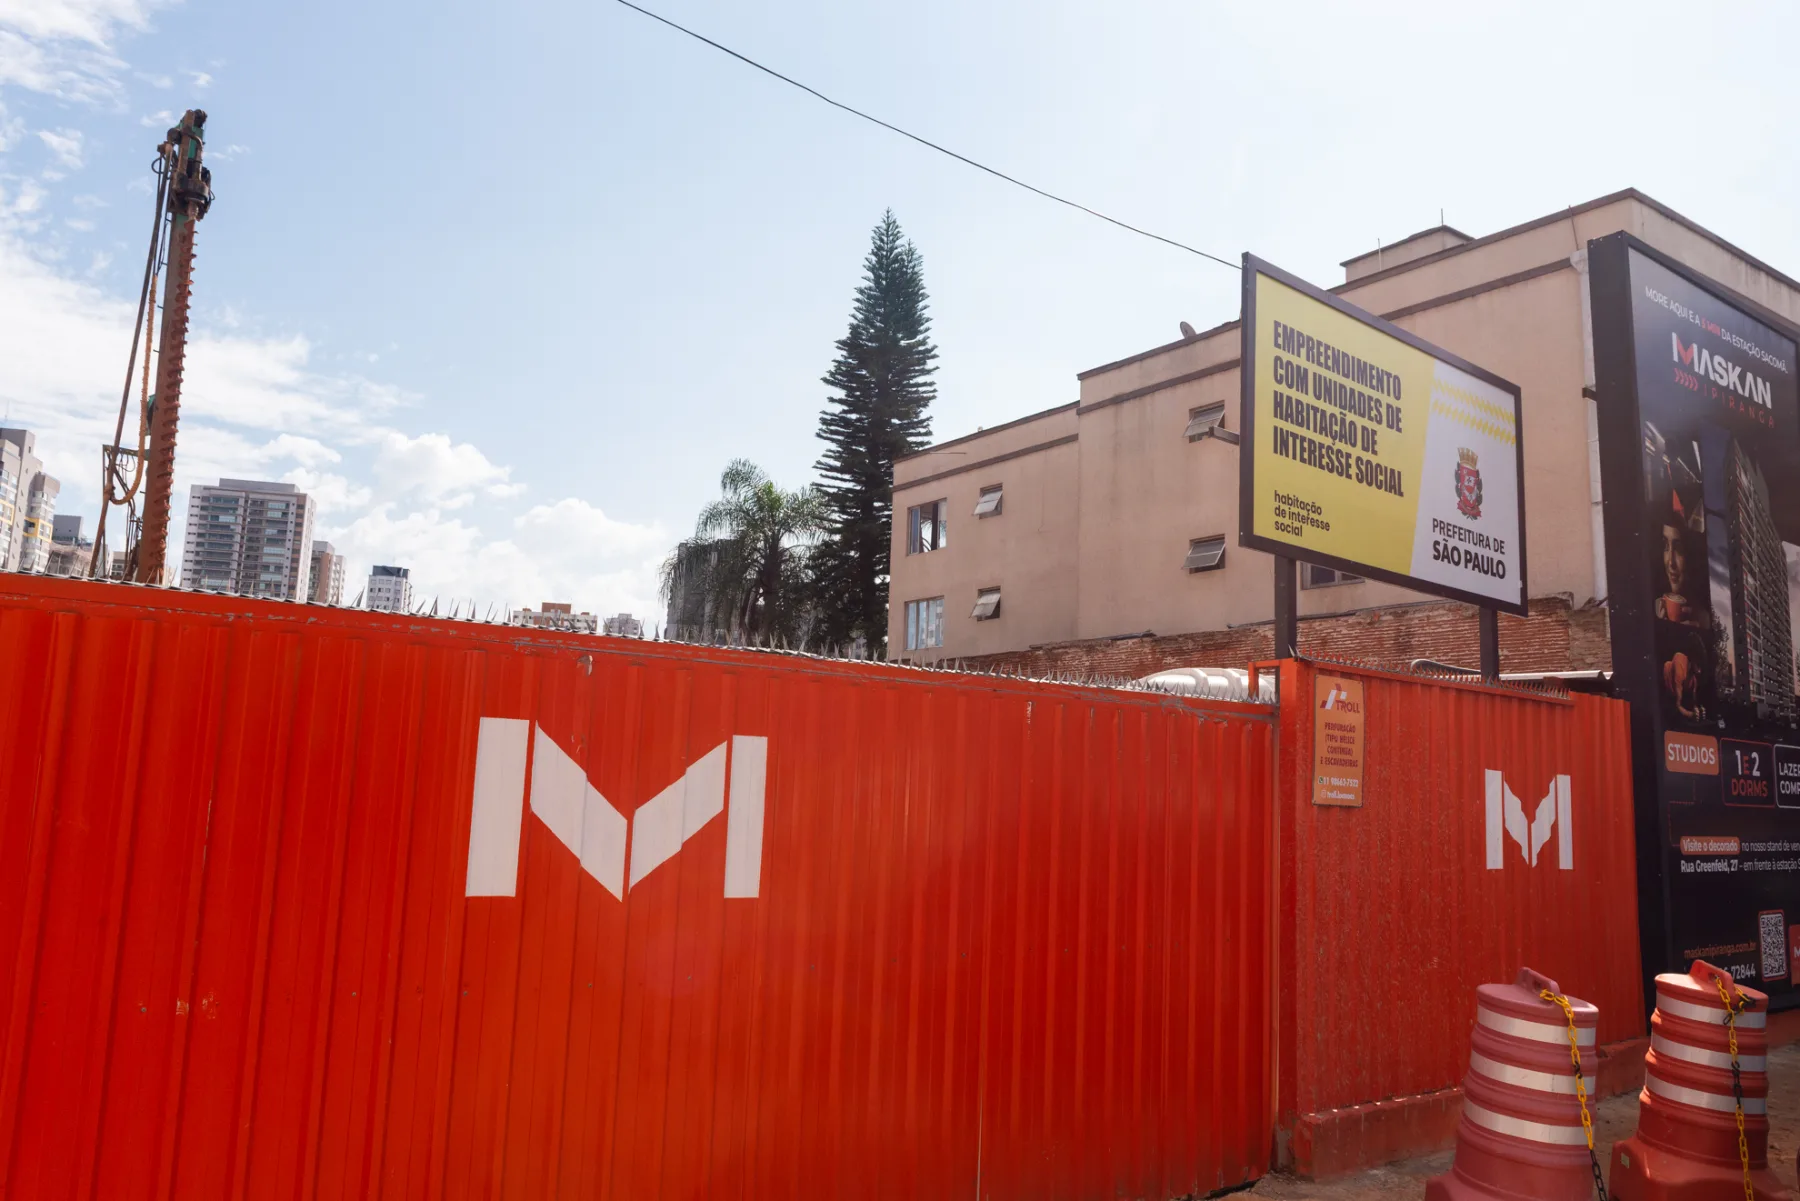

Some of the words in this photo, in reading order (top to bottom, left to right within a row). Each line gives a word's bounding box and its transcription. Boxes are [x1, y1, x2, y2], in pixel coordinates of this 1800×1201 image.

[1645, 286, 1668, 308] MORE
[1669, 300, 1688, 318] AQUI
[1689, 310, 1694, 322] E
[1694, 313, 1701, 325] A
[1721, 328, 1732, 343] DA
[1732, 336, 1761, 357] ESTAÇÃO
[1273, 320, 1402, 402] EMPREENDIMENTO
[1672, 331, 1772, 409] MASKAN
[1273, 355, 1309, 396] COM
[1313, 371, 1383, 425] UNIDADES
[1386, 402, 1403, 433] DE
[1703, 383, 1775, 428] IPIRANGA
[1273, 390, 1358, 448] HABITAÇÃO
[1360, 429, 1378, 456] DE
[1273, 425, 1353, 481] INTERESSE
[1355, 462, 1404, 497] SOCIAL
[1274, 490, 1323, 517] habitação
[1274, 504, 1287, 519] de
[1288, 507, 1331, 532] interesse
[1274, 521, 1303, 537] social
[1432, 518, 1491, 550] PREFEITURA
[1493, 539, 1506, 555] DE
[1432, 540, 1461, 567] SÃO
[1464, 549, 1506, 580] PAULO
[1335, 699, 1360, 713] TROLL
[1324, 722, 1356, 733] PERFURAÇÃO
[1667, 743, 1716, 765] STUDIOS
[1735, 750, 1742, 775] 1
[1743, 755, 1749, 775] E
[1751, 751, 1760, 776] 2
[1731, 778, 1768, 797] DORMS
[1682, 838, 1702, 852] Visite
[1703, 842, 1708, 852] o
[1709, 839, 1738, 852] decorado
[1741, 842, 1749, 852] no
[1750, 842, 1767, 852] nosso
[1767, 840, 1783, 852] stand
[1783, 840, 1790, 852] de
[1680, 860, 1694, 873] Rua
[1695, 858, 1730, 874] Greenfeld,
[1730, 859, 1738, 871] 27
[1743, 862, 1753, 871] em
[1754, 858, 1772, 871] frente
[1776, 858, 1797, 873] estação
[1684, 941, 1757, 959] maskanipiranga.com.br
